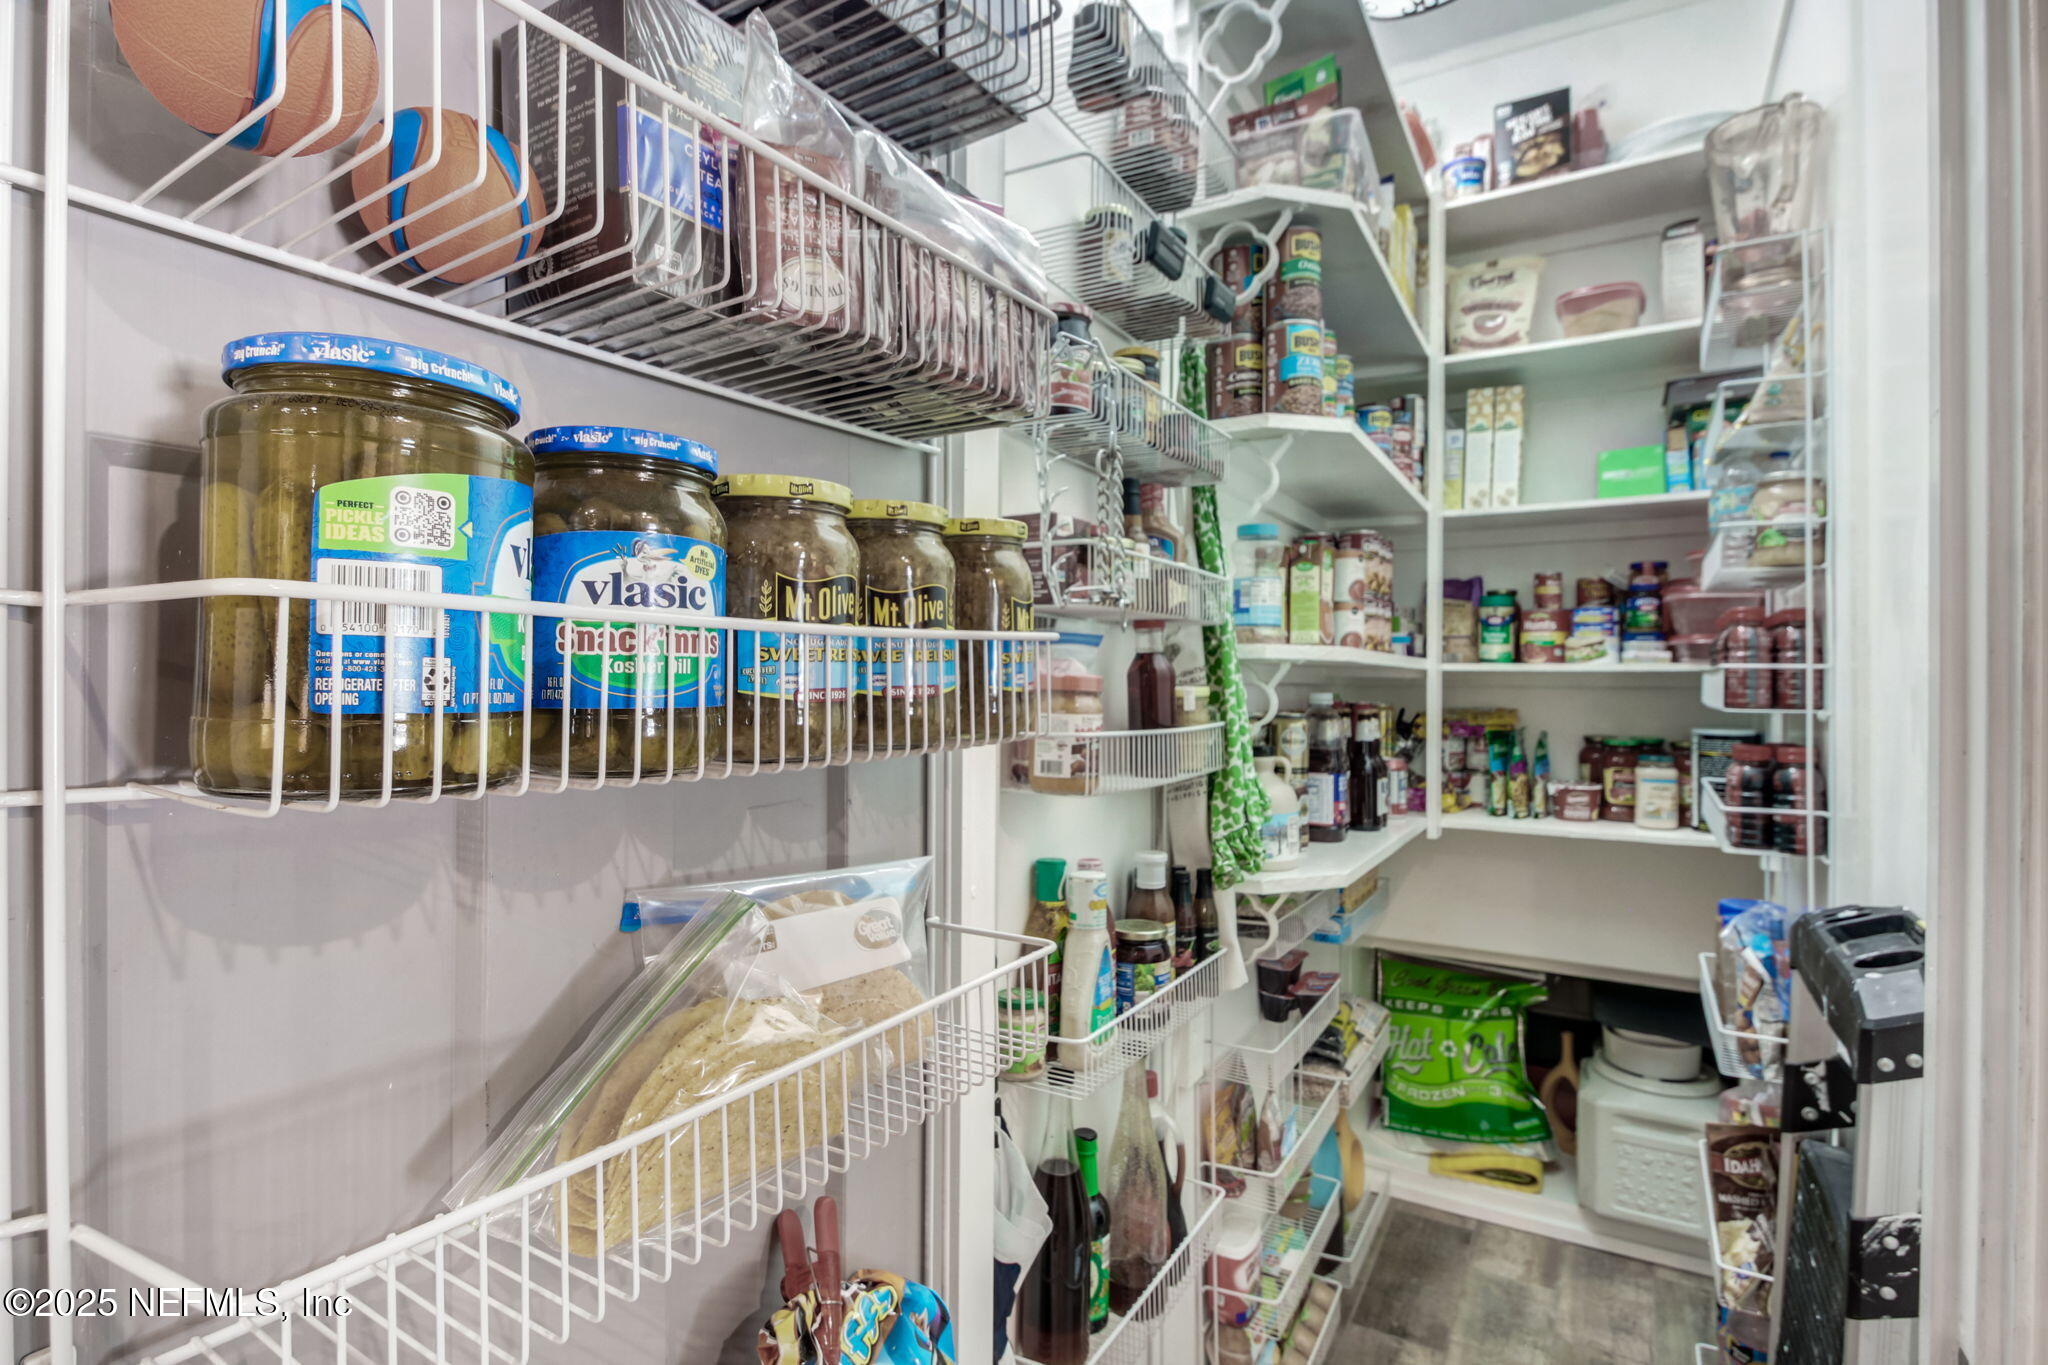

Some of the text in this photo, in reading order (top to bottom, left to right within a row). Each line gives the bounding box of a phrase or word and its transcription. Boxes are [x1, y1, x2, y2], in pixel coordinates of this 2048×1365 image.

[684, 143, 723, 170] CEYL
[783, 278, 844, 298] TWNIGS
[313, 344, 370, 363] vlasic
[336, 499, 375, 510] PERFECT
[324, 508, 385, 525] PICKLE
[324, 523, 385, 543] IDEAS
[699, 549, 709, 558] No
[689, 555, 715, 571] Artificial
[694, 564, 710, 578] DYES
[581, 572, 707, 611] vlasic
[785, 585, 855, 621] Mt. Olive
[874, 593, 944, 627] Mt. Olive
[315, 649, 353, 658] Quesons
[760, 647, 825, 663] SWEET
[852, 649, 905, 663] SWEE
[915, 649, 954, 663] RELSH
[605, 656, 664, 675] Koser
[315, 677, 416, 692] REFIGERATE FTER
[917, 686, 936, 696] 126
[315, 692, 359, 706] OPEING
[858, 915, 894, 937] Great
[1385, 999, 1444, 1014] KEEPS
